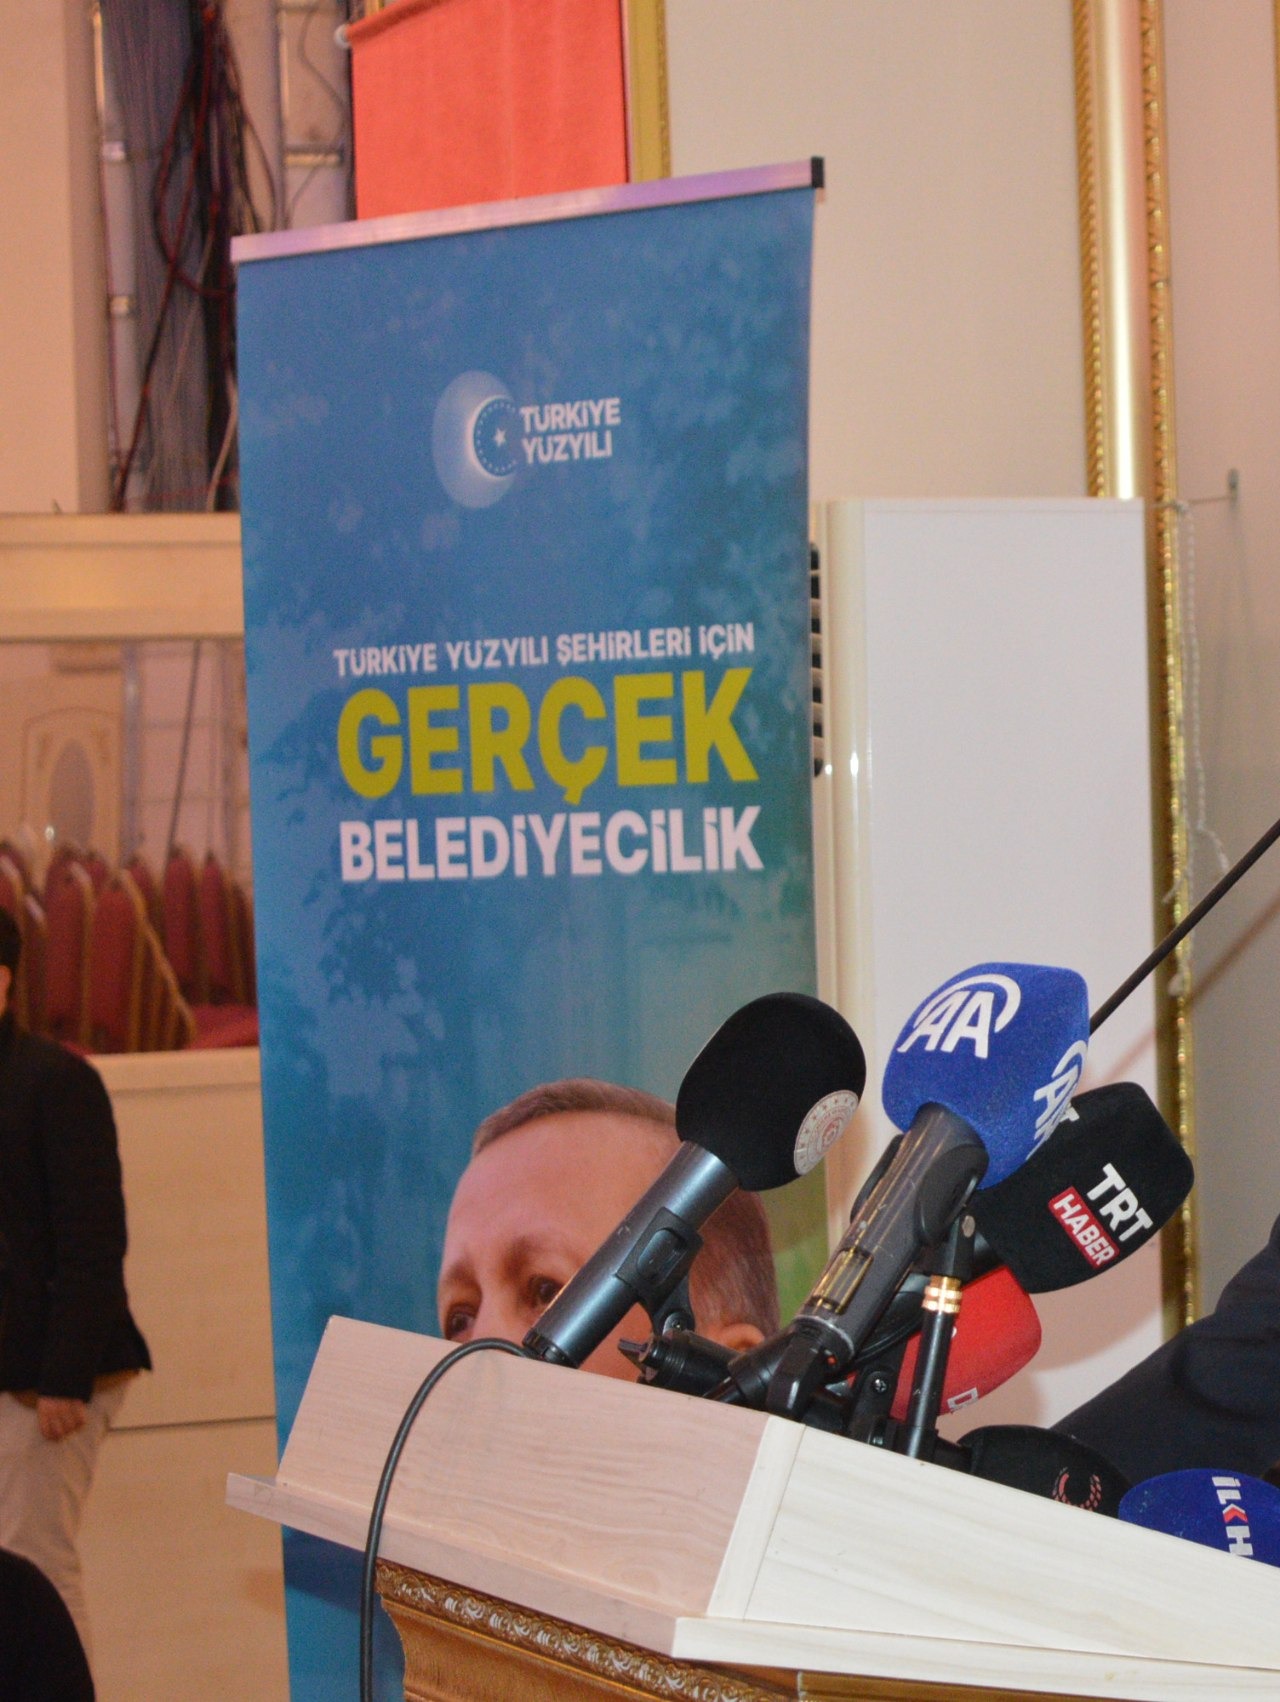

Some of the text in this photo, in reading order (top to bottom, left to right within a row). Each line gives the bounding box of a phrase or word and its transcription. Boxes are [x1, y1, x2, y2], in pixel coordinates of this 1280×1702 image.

[556, 626, 691, 666] ŞEHİRLERİ
[698, 622, 755, 660] İÇİN
[337, 668, 759, 805] GERÇEK
[340, 806, 764, 882] BELEDİYECİLİK
[897, 984, 1006, 1059] AA
[1053, 1194, 1115, 1266] HABER
[1087, 1163, 1154, 1242] TRT
